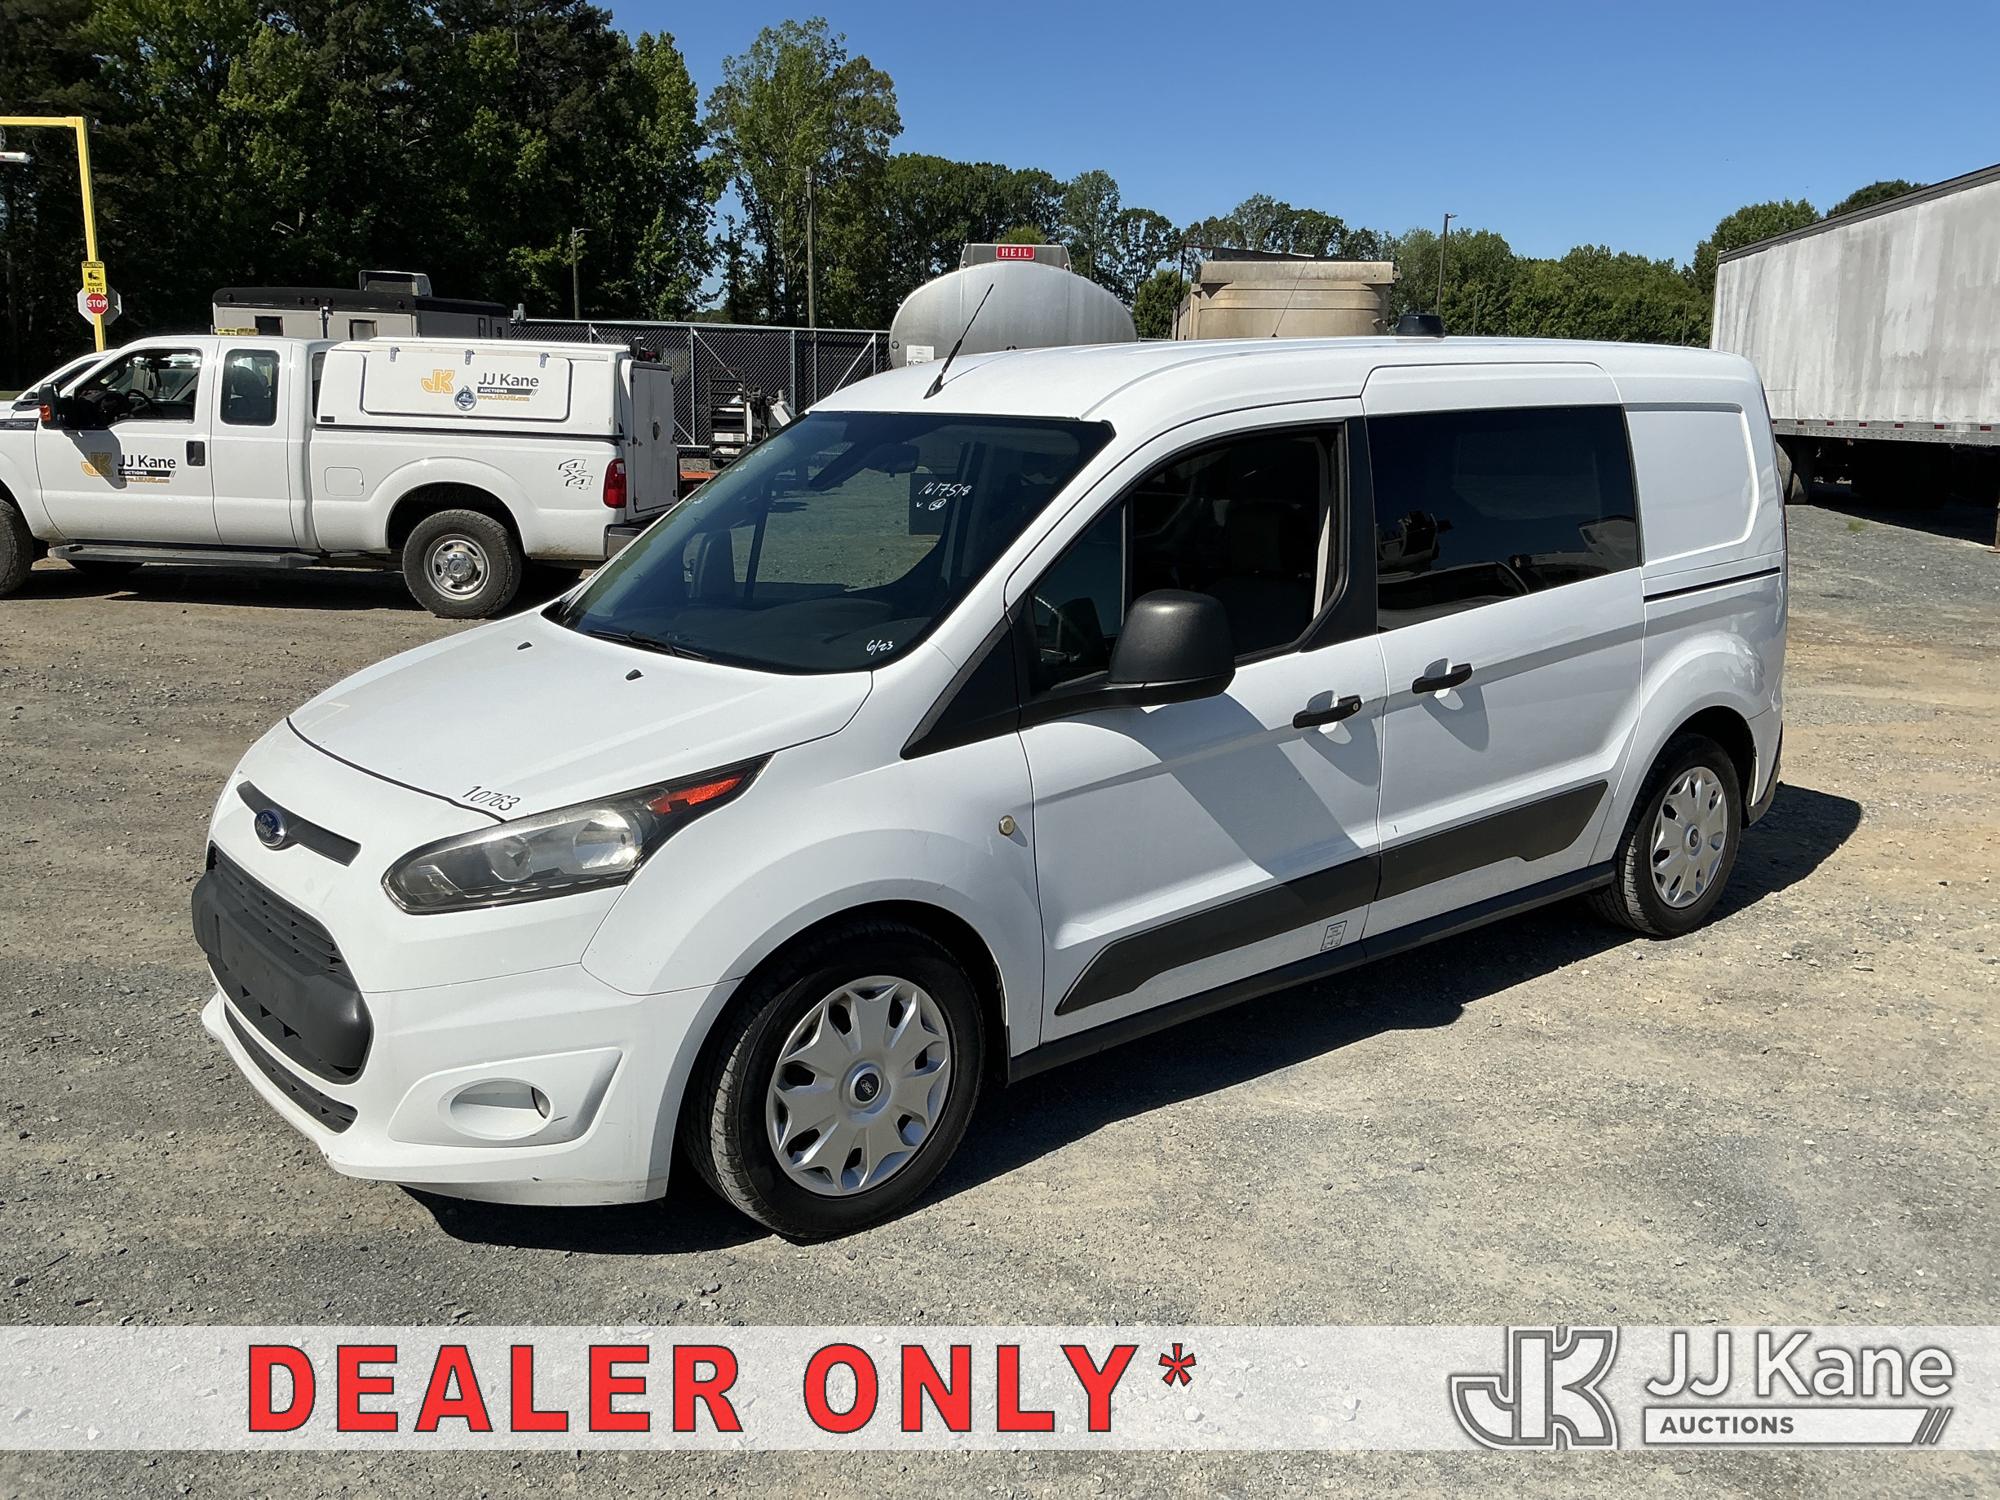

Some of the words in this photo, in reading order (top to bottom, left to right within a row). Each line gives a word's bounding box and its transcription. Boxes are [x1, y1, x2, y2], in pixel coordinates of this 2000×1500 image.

[1001, 247, 1029, 257] HEIL
[478, 373, 496, 386] JJ
[500, 373, 539, 387] Kane
[118, 454, 134, 467] JJ
[138, 454, 176, 468] Kane
[866, 639, 894, 656] 6/23
[462, 785, 521, 811] 10763
